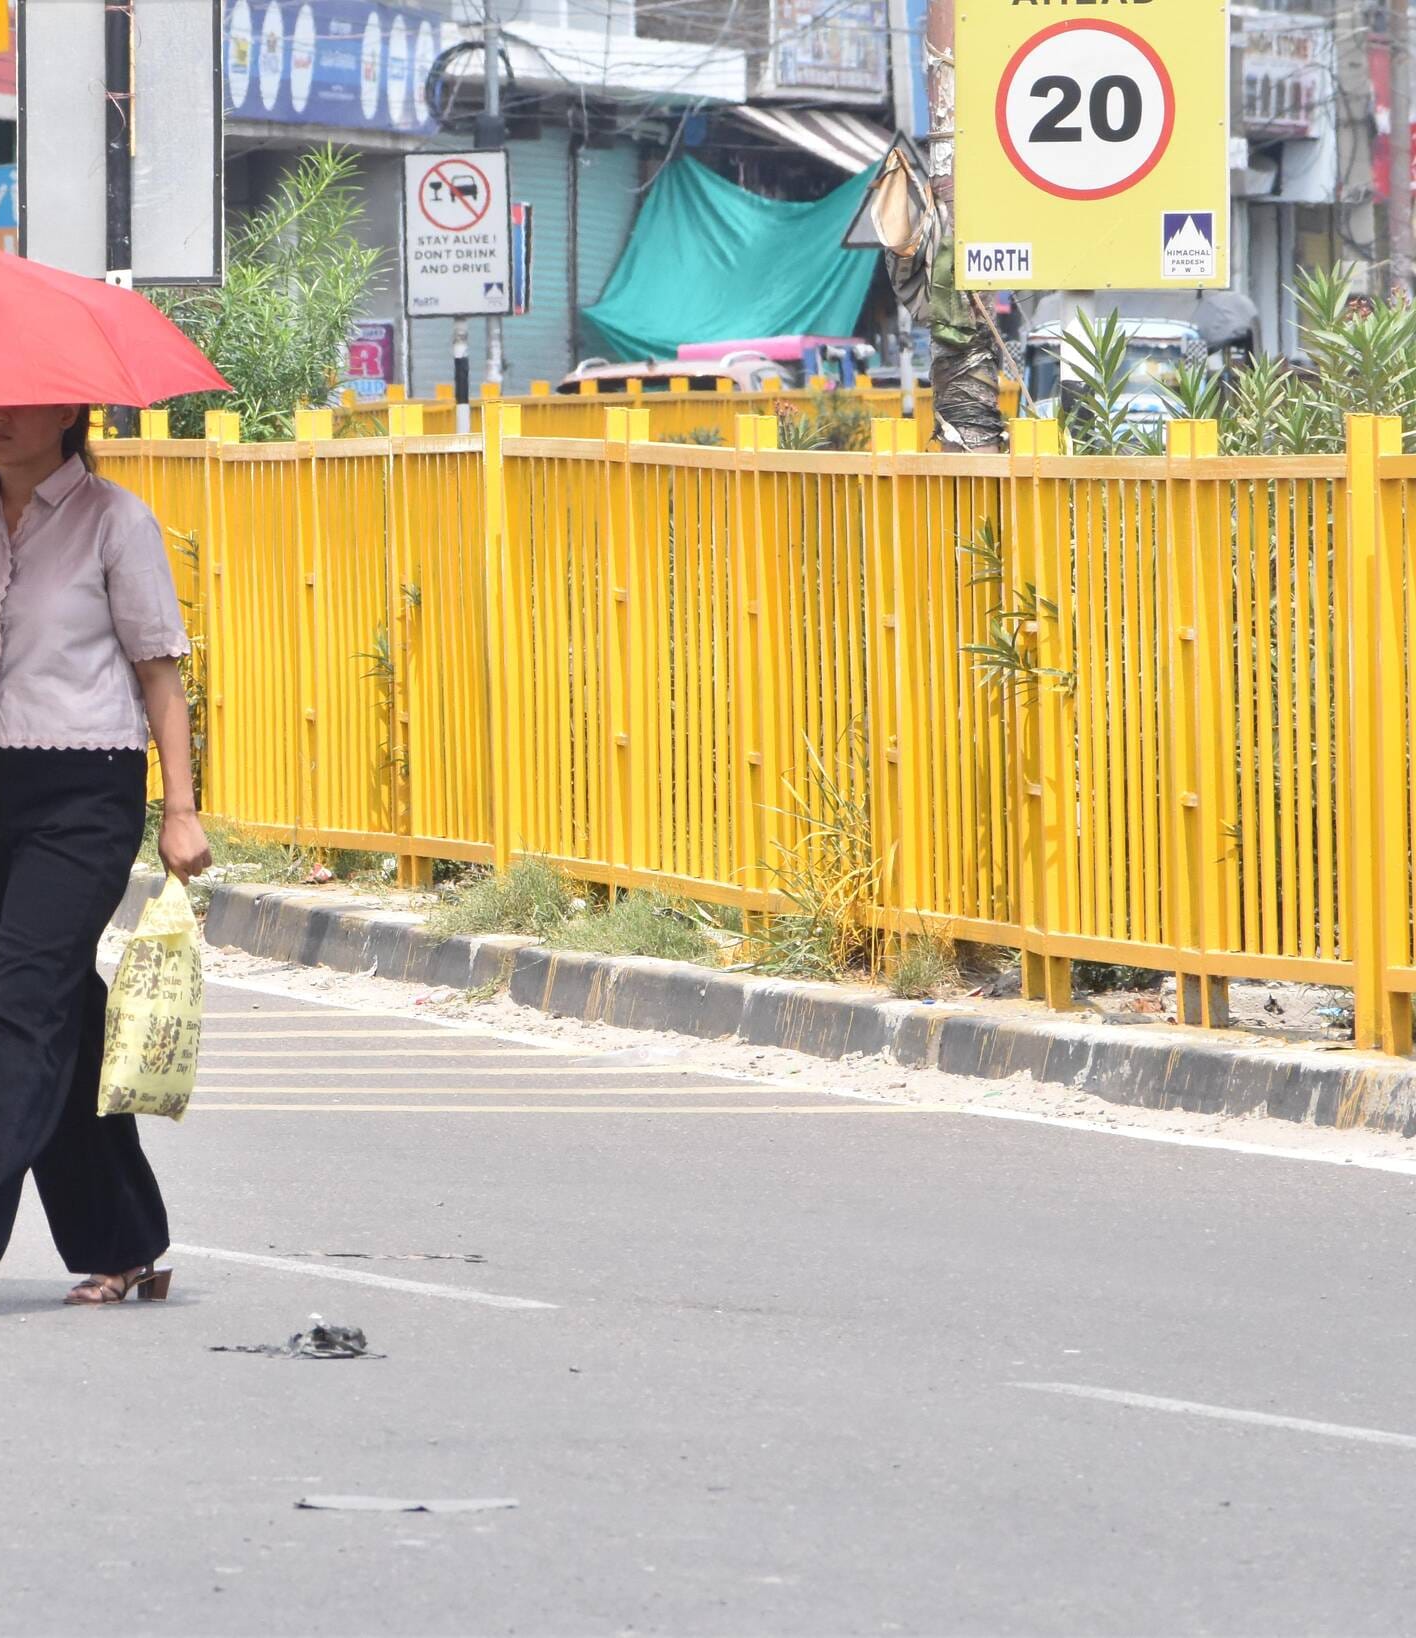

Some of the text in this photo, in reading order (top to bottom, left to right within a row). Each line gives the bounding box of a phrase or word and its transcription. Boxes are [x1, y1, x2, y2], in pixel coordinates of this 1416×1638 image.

[1028, 75, 1143, 143] 20
[417, 235, 449, 246] STAY
[452, 234, 490, 245] ALIVE
[455, 249, 497, 260] DRINK
[967, 249, 1030, 272] MoRTH
[420, 263, 491, 274] AND DRIVE
